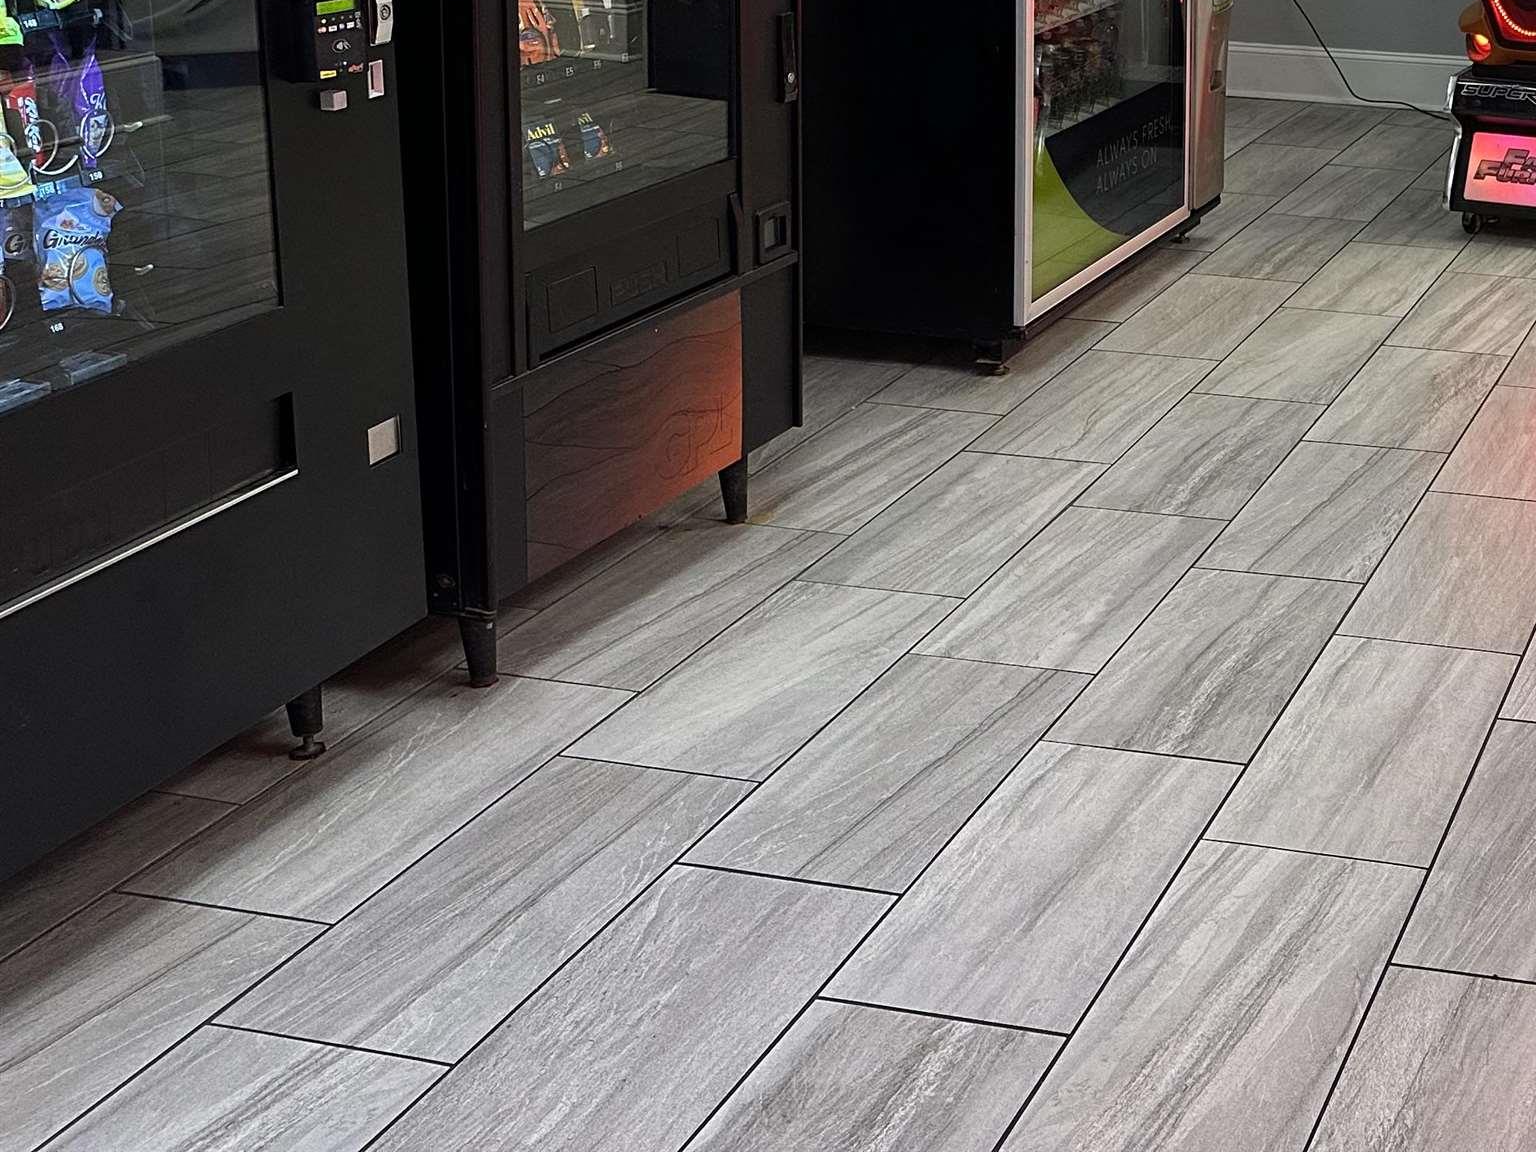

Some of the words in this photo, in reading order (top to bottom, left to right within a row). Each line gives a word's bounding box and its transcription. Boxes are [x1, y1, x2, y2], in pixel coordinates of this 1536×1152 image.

[527, 123, 556, 141] Advil
[1096, 130, 1138, 168] ALWAYS
[1142, 114, 1171, 142] FRESH
[1095, 155, 1138, 194] ALWAYS
[1141, 149, 1159, 169] ON
